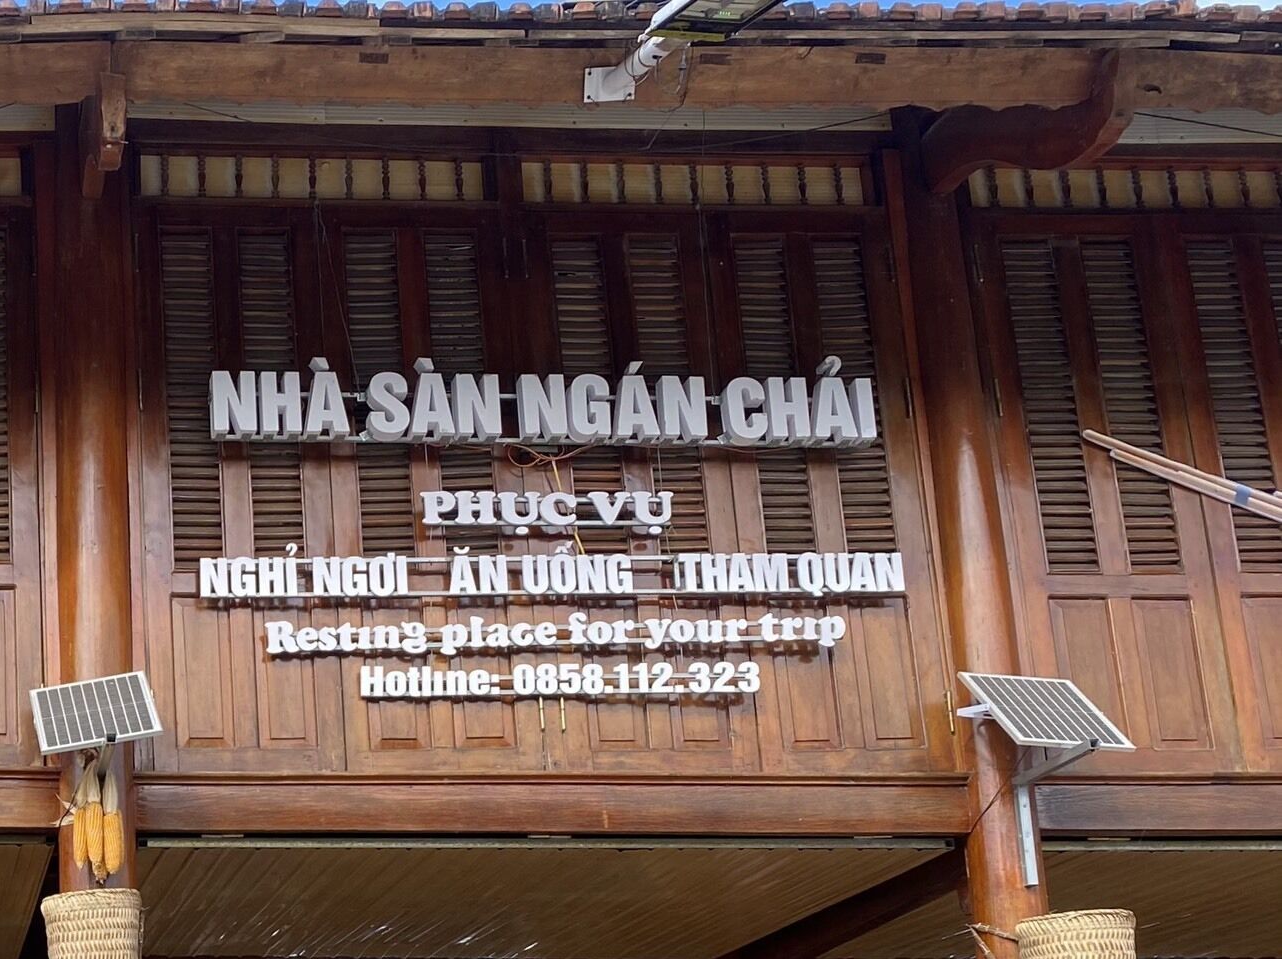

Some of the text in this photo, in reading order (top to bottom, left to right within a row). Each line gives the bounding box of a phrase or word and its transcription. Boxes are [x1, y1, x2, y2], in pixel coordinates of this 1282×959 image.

[209, 355, 877, 445] NHÀ SÀN NGÁN CHẢI
[420, 490, 675, 535] PHỤC VỤ
[200, 540, 906, 598] NGHỈ NGƠI ĂN UỐNG THAM QUAN
[265, 611, 846, 656] Resting place for your trip
[360, 661, 761, 698] Hotline: 0858.112.323
